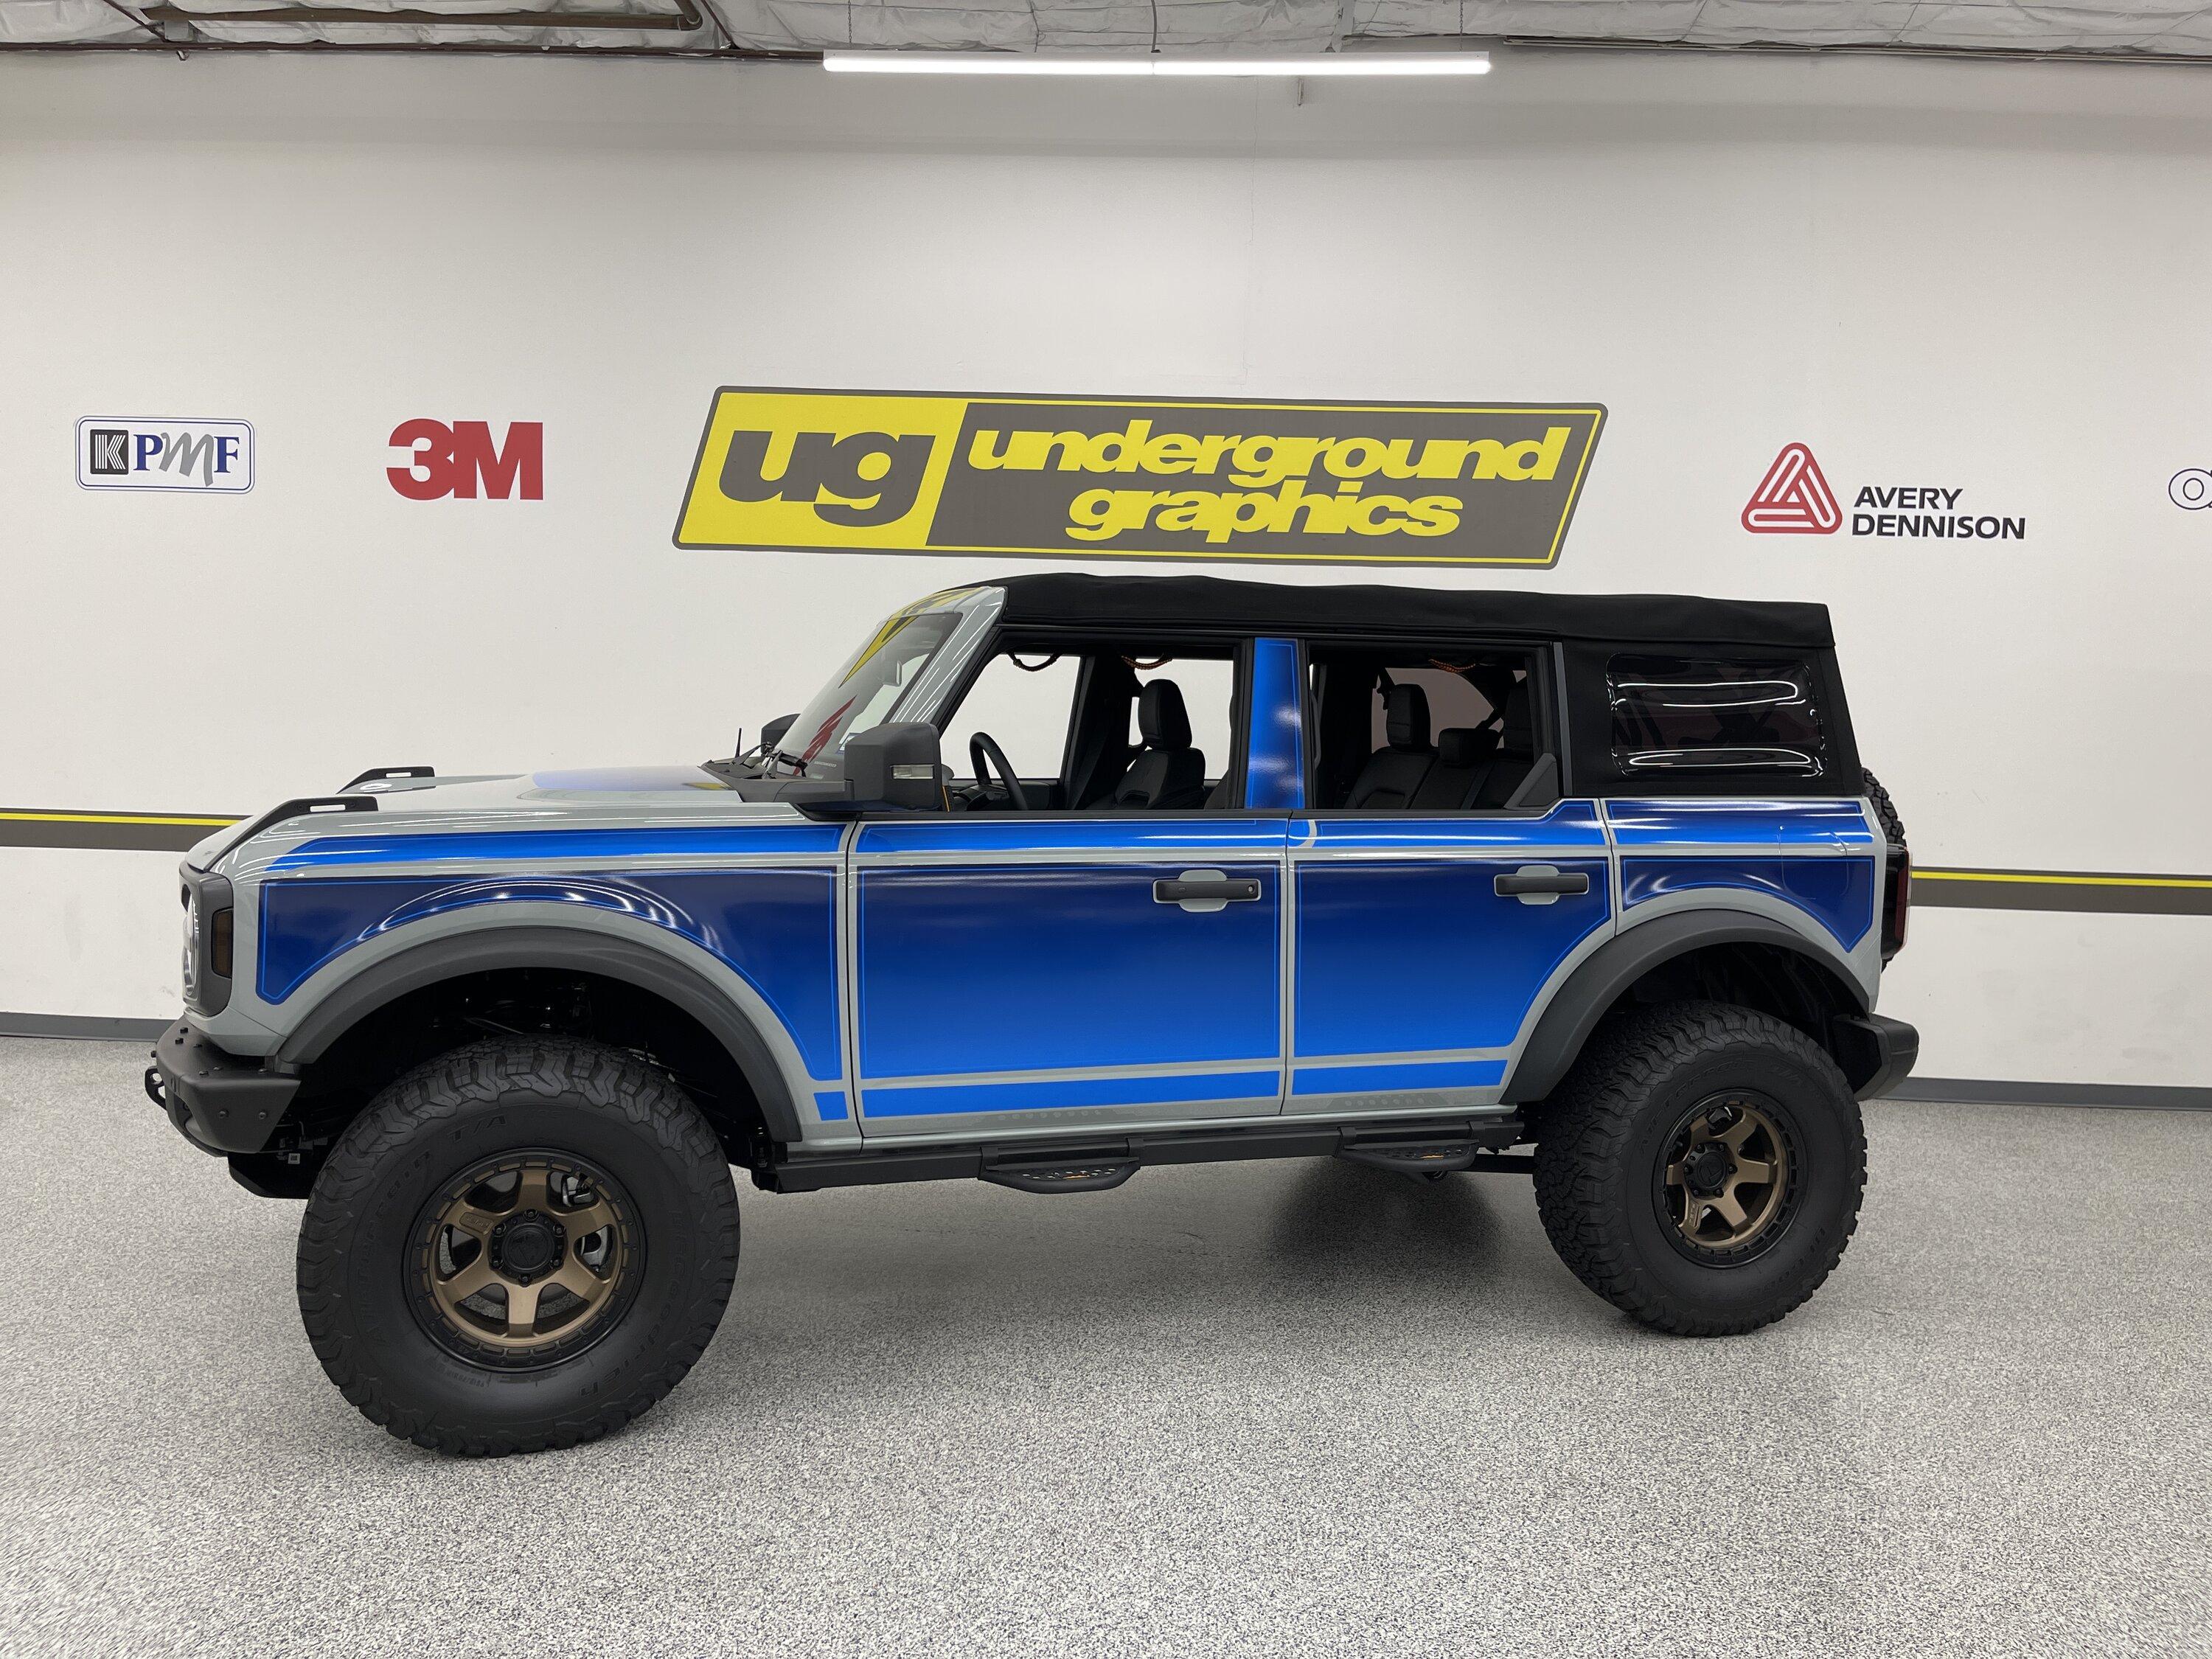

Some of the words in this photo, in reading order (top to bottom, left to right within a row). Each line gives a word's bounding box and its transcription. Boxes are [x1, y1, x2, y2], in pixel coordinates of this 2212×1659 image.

[386, 418, 543, 501] 3M
[719, 431, 936, 527] ug
[967, 419, 1572, 488] underground
[1064, 479, 1464, 544] graphics
[1851, 513, 2026, 540] DENNISON
[1854, 486, 1964, 510] AVERY
